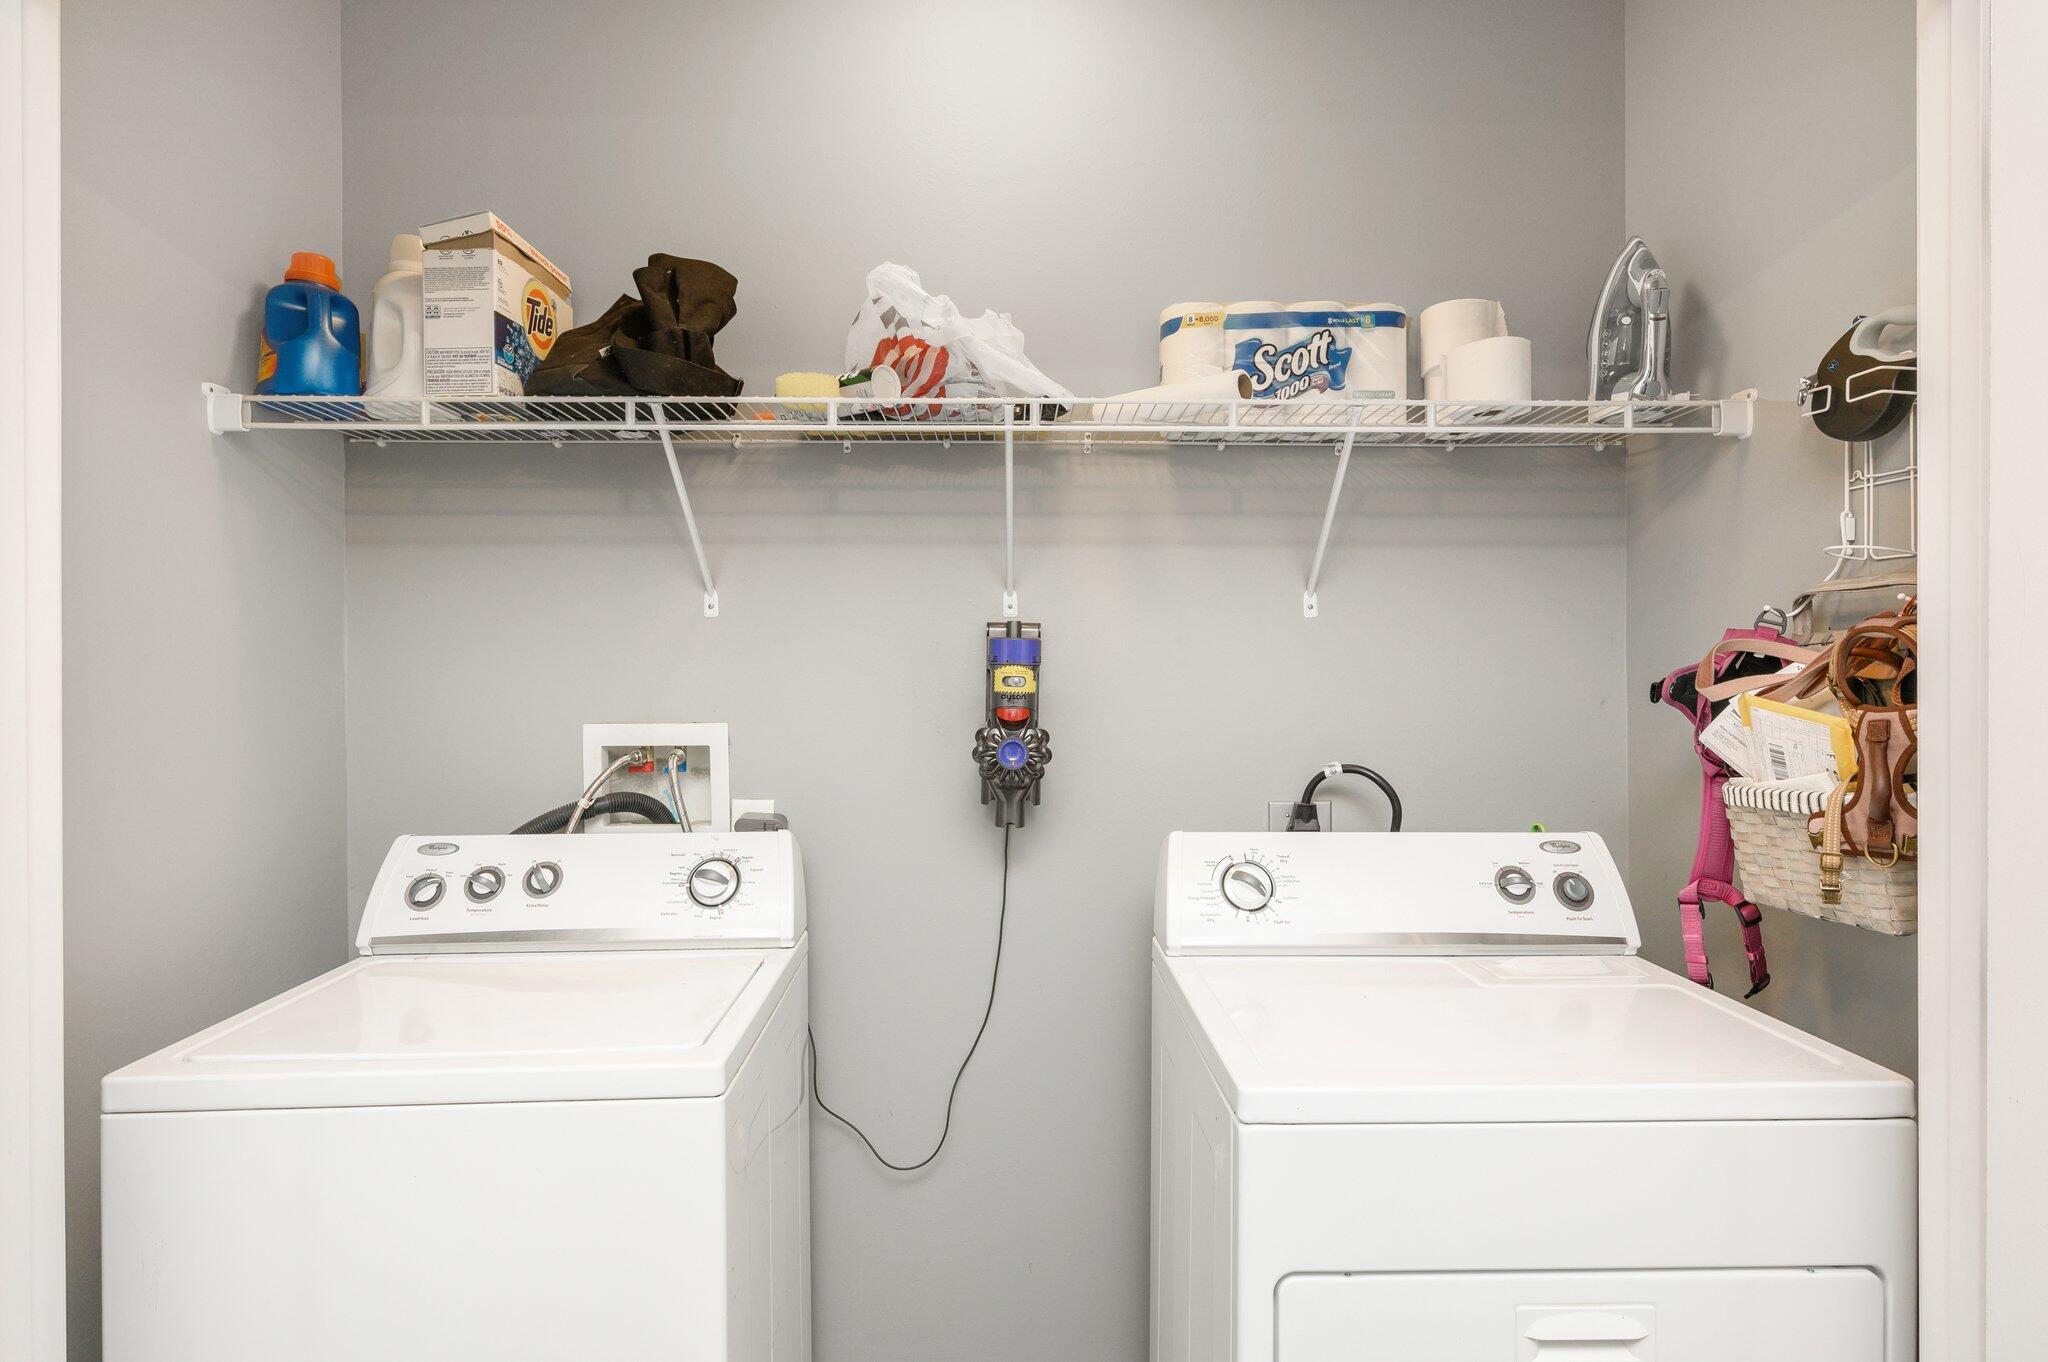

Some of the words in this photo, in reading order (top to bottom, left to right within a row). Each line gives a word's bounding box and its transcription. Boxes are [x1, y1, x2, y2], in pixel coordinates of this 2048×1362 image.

[525, 297, 554, 338] Tide
[1250, 329, 1333, 392] Scott
[1274, 375, 1311, 399] 1000
[1000, 694, 1027, 702] dyson
